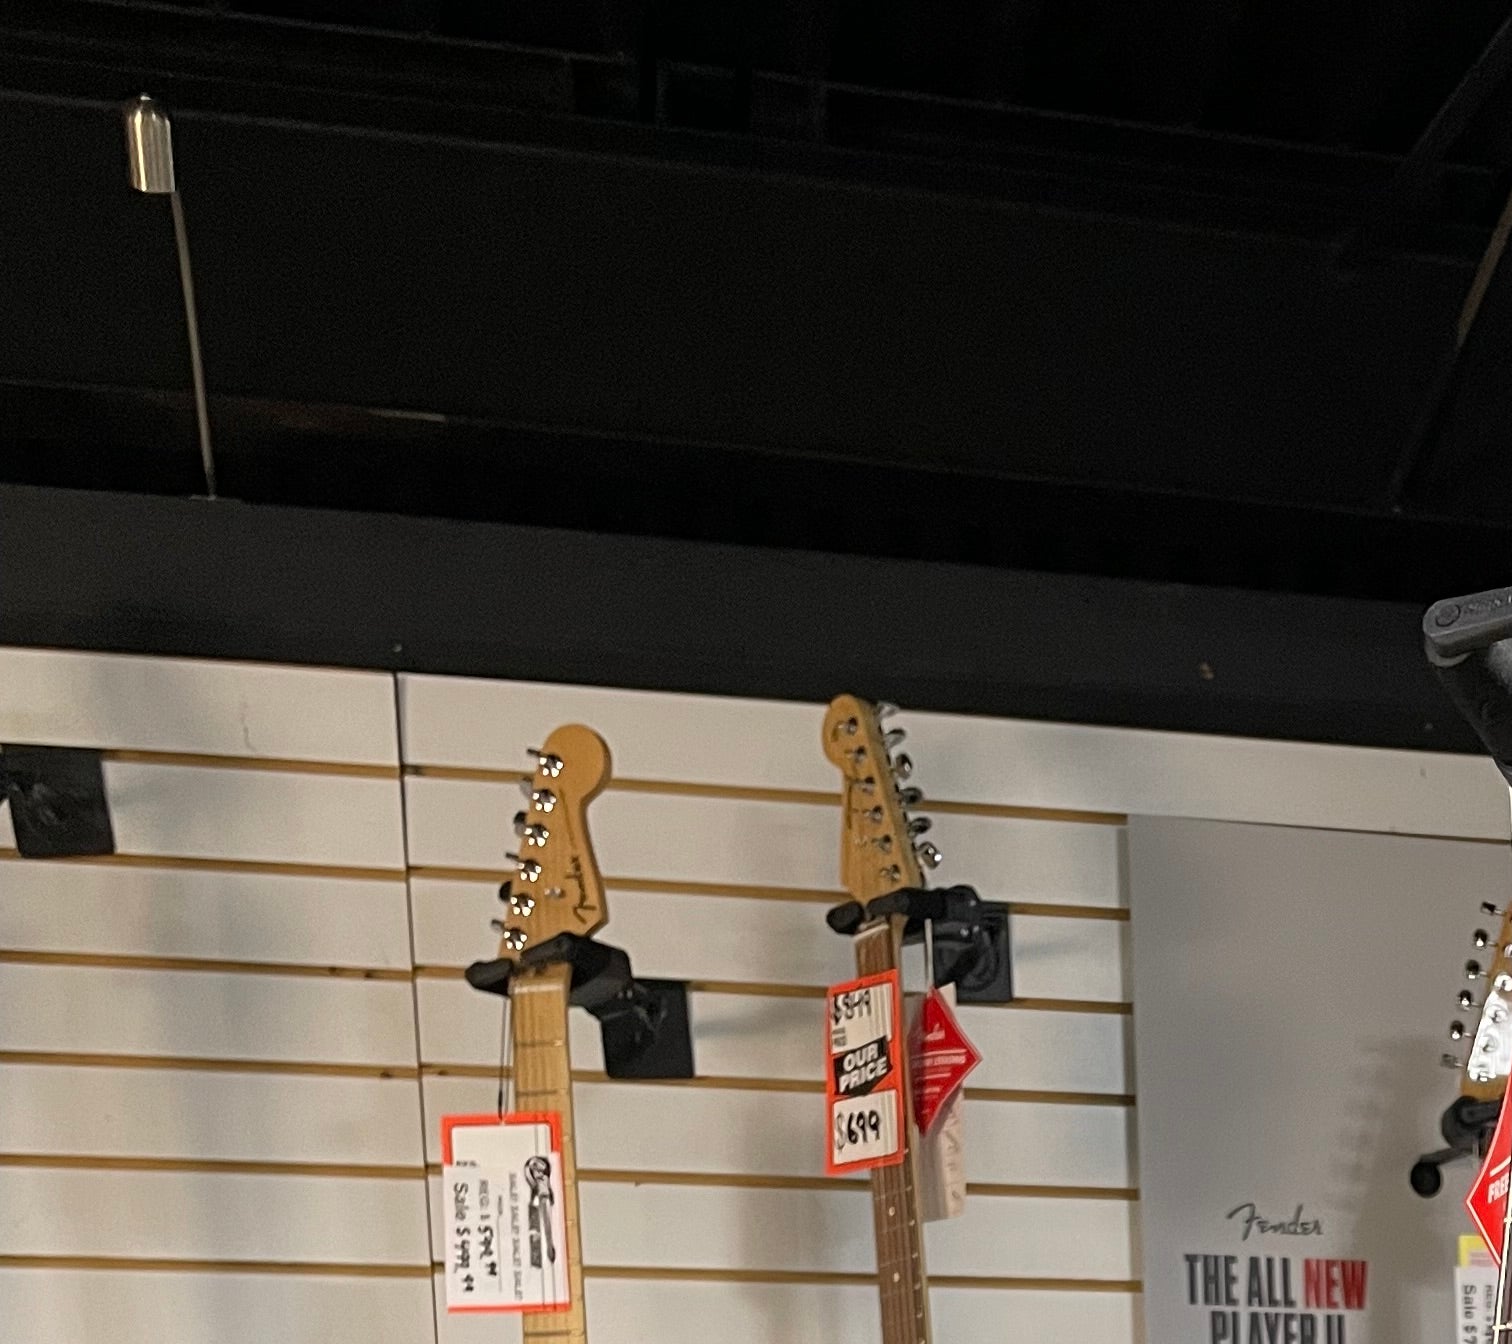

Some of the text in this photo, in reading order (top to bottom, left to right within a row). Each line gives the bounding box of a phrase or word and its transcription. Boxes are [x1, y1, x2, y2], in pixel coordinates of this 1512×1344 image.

[838, 1056, 889, 1094] PRICE
[843, 1043, 879, 1072] OUR
[1226, 1203, 1323, 1241] Fender
[1184, 1254, 1368, 1311] THE ALL NEW
[1462, 1284, 1478, 1319] Sale
